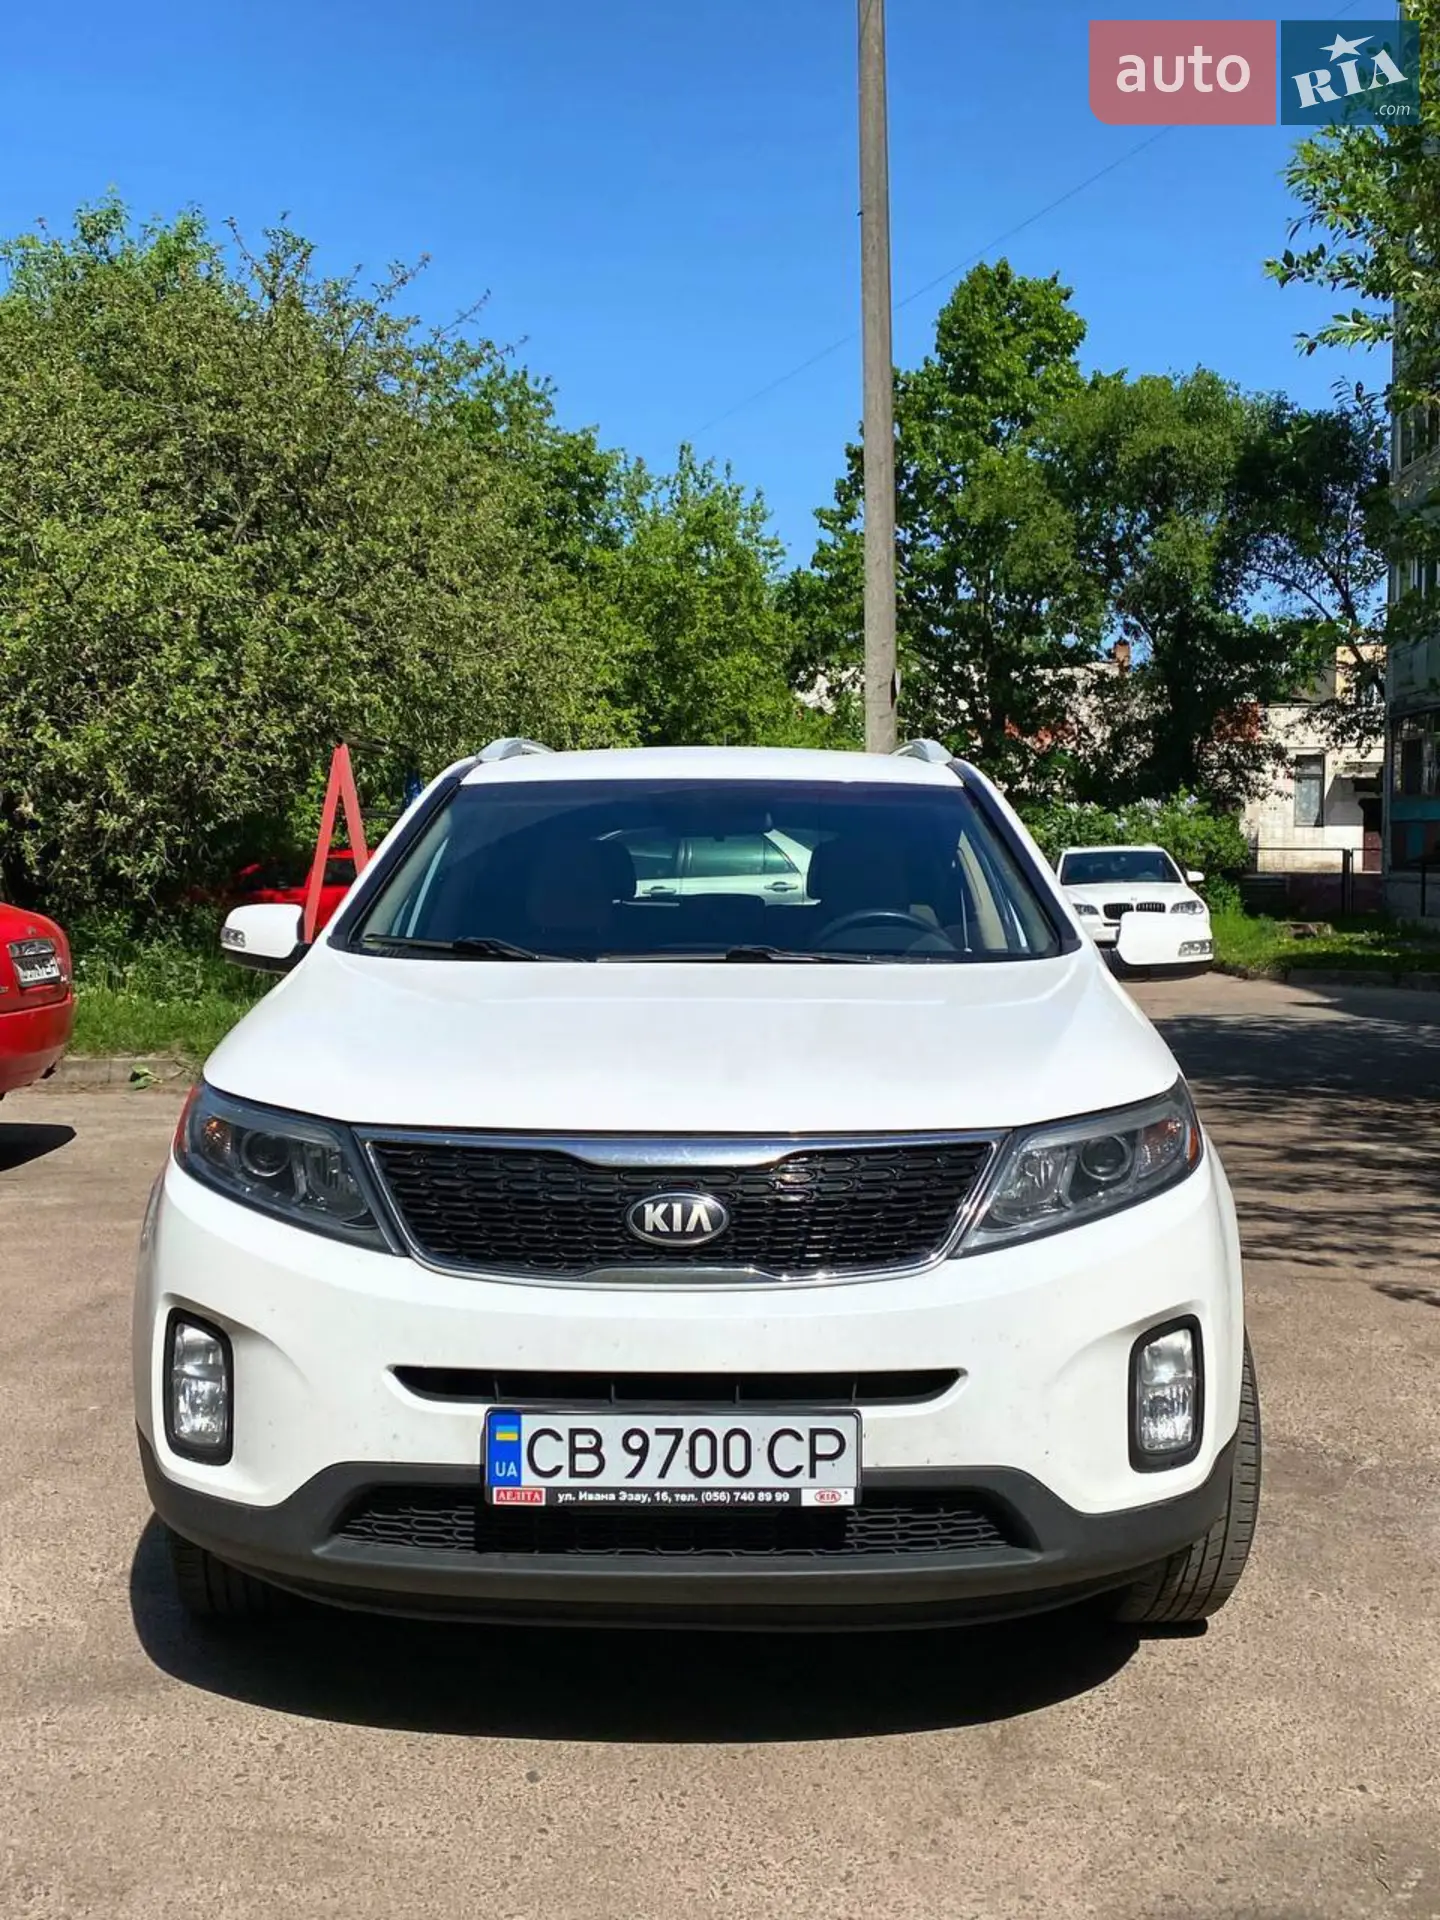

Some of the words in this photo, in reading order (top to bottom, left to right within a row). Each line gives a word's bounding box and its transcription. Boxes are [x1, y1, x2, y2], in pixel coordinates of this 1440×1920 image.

[644, 1202, 713, 1232] KIA
[526, 1428, 606, 1479] CB
[621, 1428, 752, 1479] 9700
[767, 1428, 847, 1479] CP
[495, 1462, 518, 1477] UA
[558, 1493, 576, 1503] ул.
[578, 1491, 616, 1501] Ивана
[654, 1491, 672, 1504] 16,
[674, 1493, 699, 1502] тел.
[701, 1491, 731, 1504] (056)
[733, 1492, 755, 1502] 740
[757, 1492, 773, 1502] 89
[774, 1492, 790, 1502] 99
